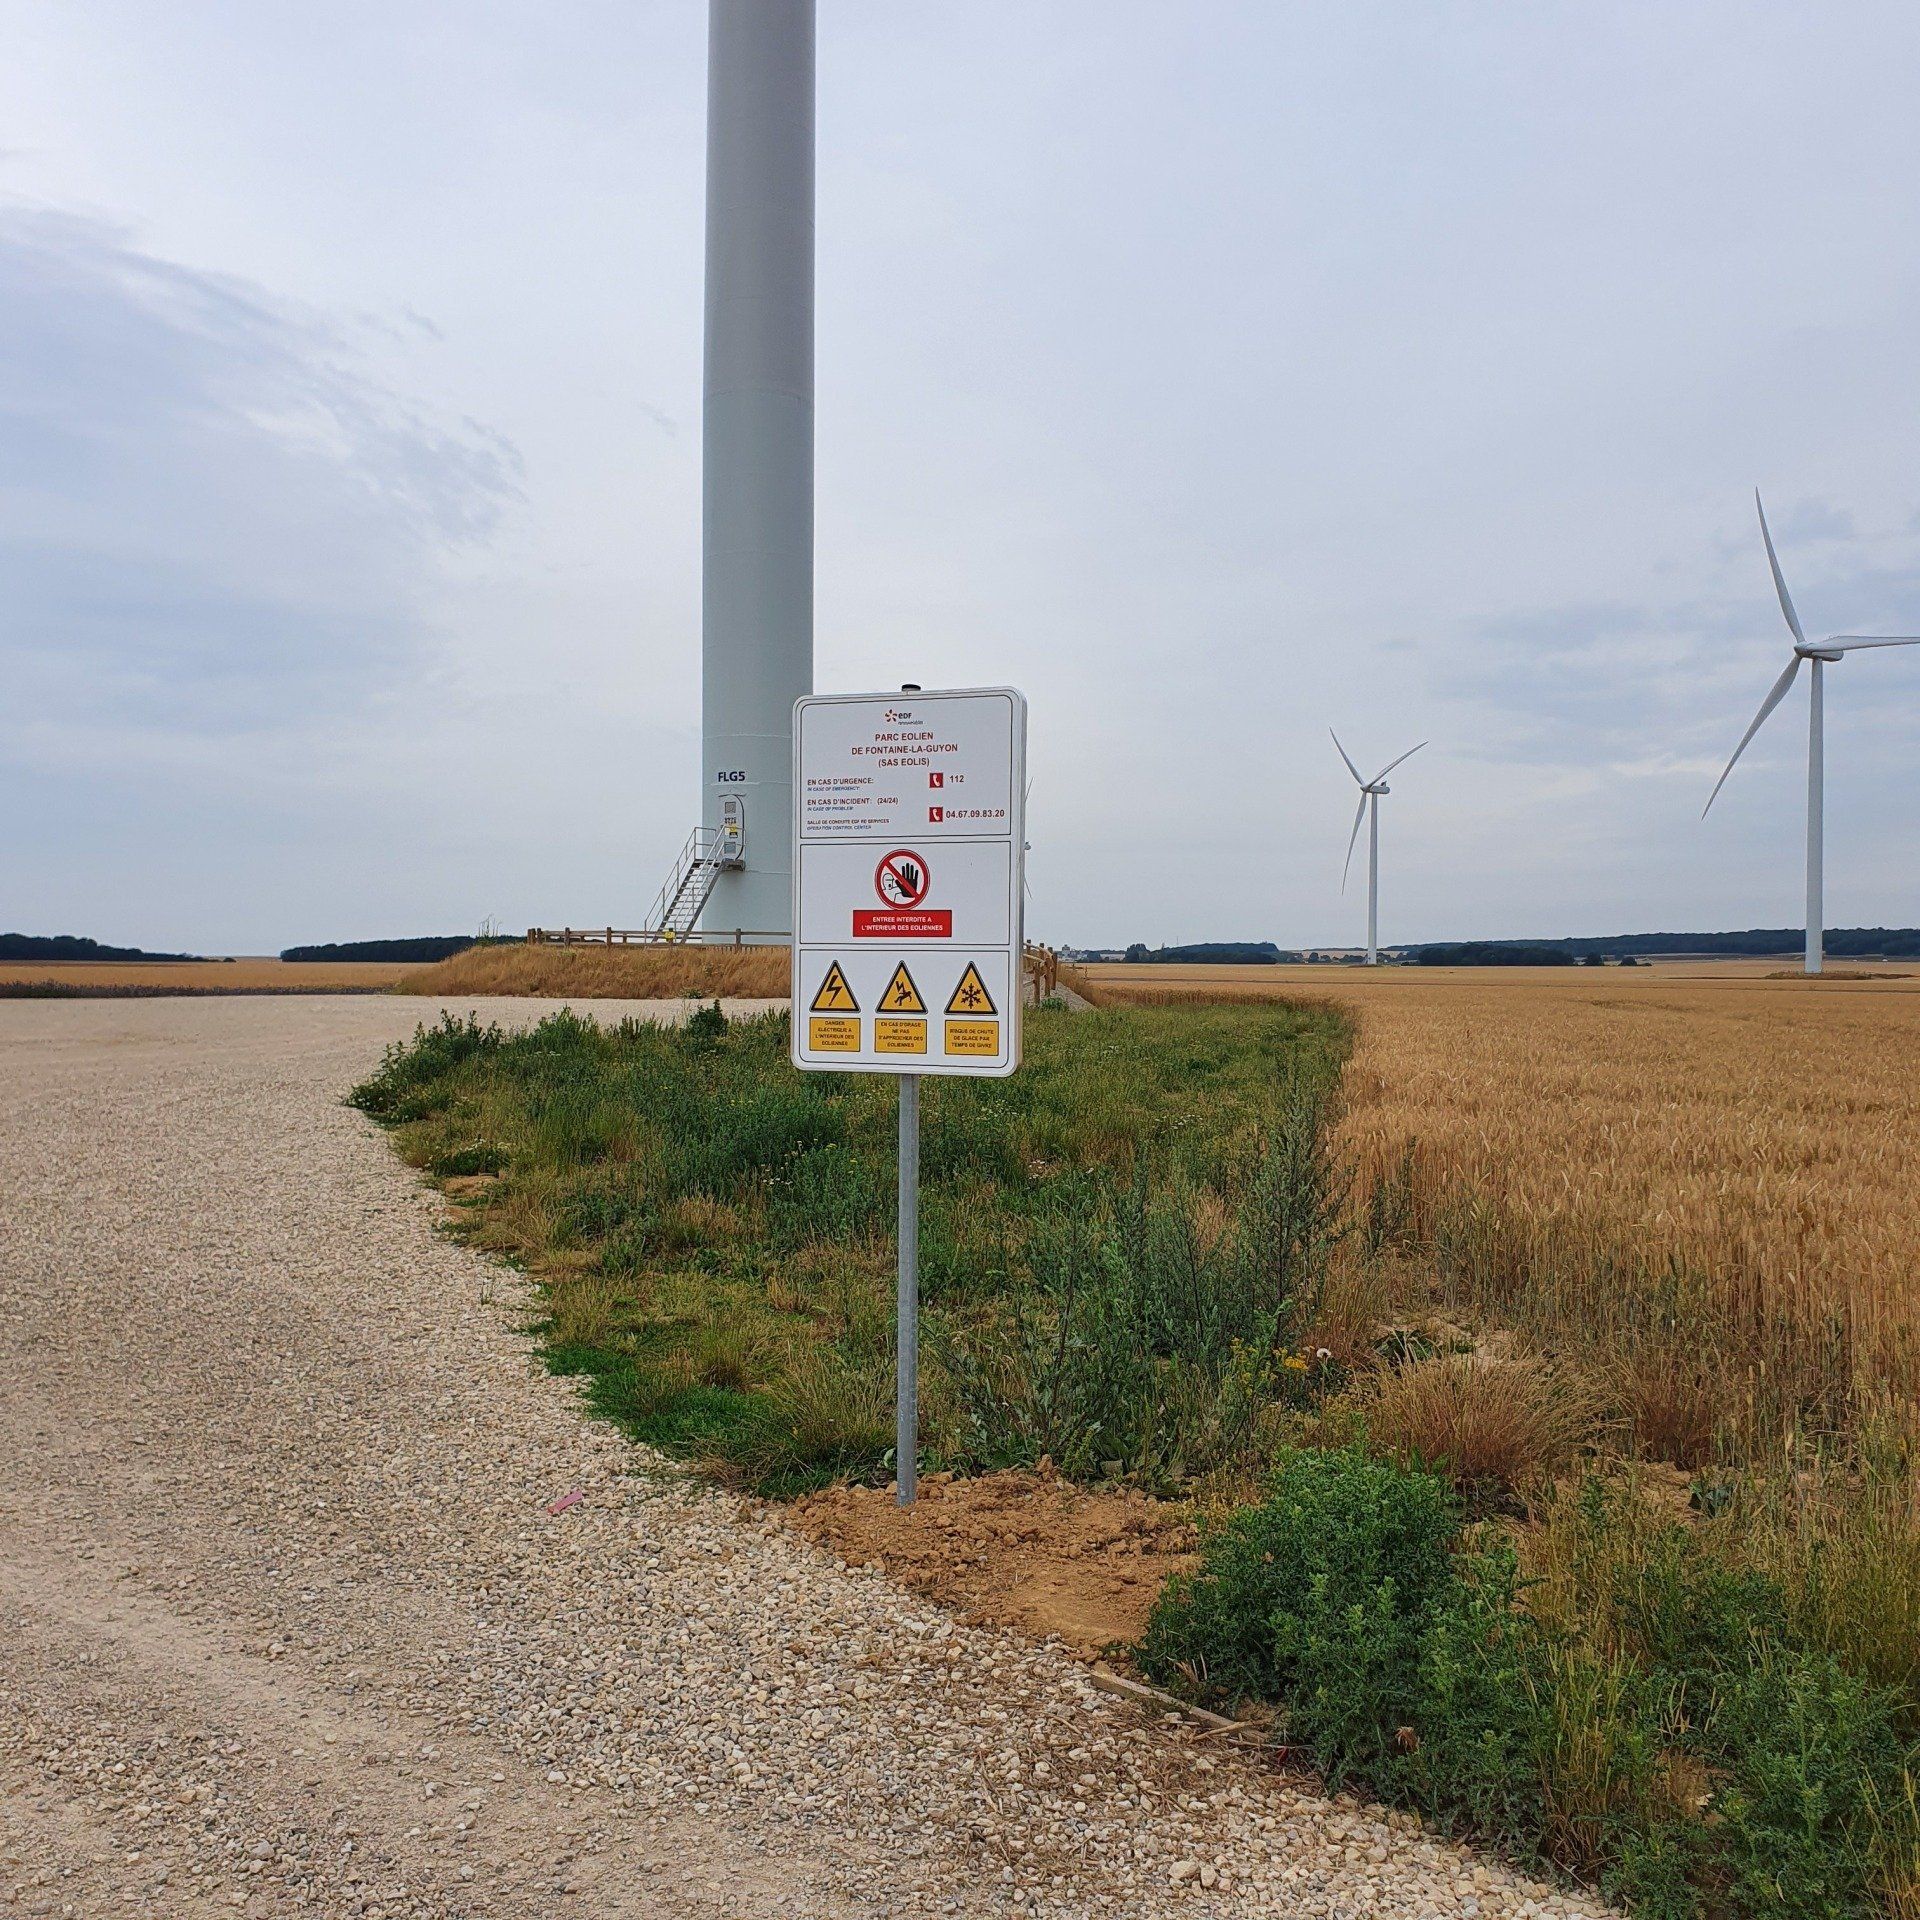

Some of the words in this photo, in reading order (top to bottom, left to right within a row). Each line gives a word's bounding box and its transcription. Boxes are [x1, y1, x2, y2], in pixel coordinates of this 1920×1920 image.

[875, 733, 899, 741] PARC
[901, 732, 934, 740] EOLIEN
[851, 747, 863, 755] DE
[865, 744, 958, 755] FONTAINE-LA-GUYON
[878, 758, 899, 768] (SAS
[901, 757, 930, 768] EOLIS)
[718, 771, 746, 782] FLG5
[950, 774, 965, 783] 112
[877, 797, 898, 806] (24/24)
[946, 810, 1005, 818] 04.67.09.83.20
